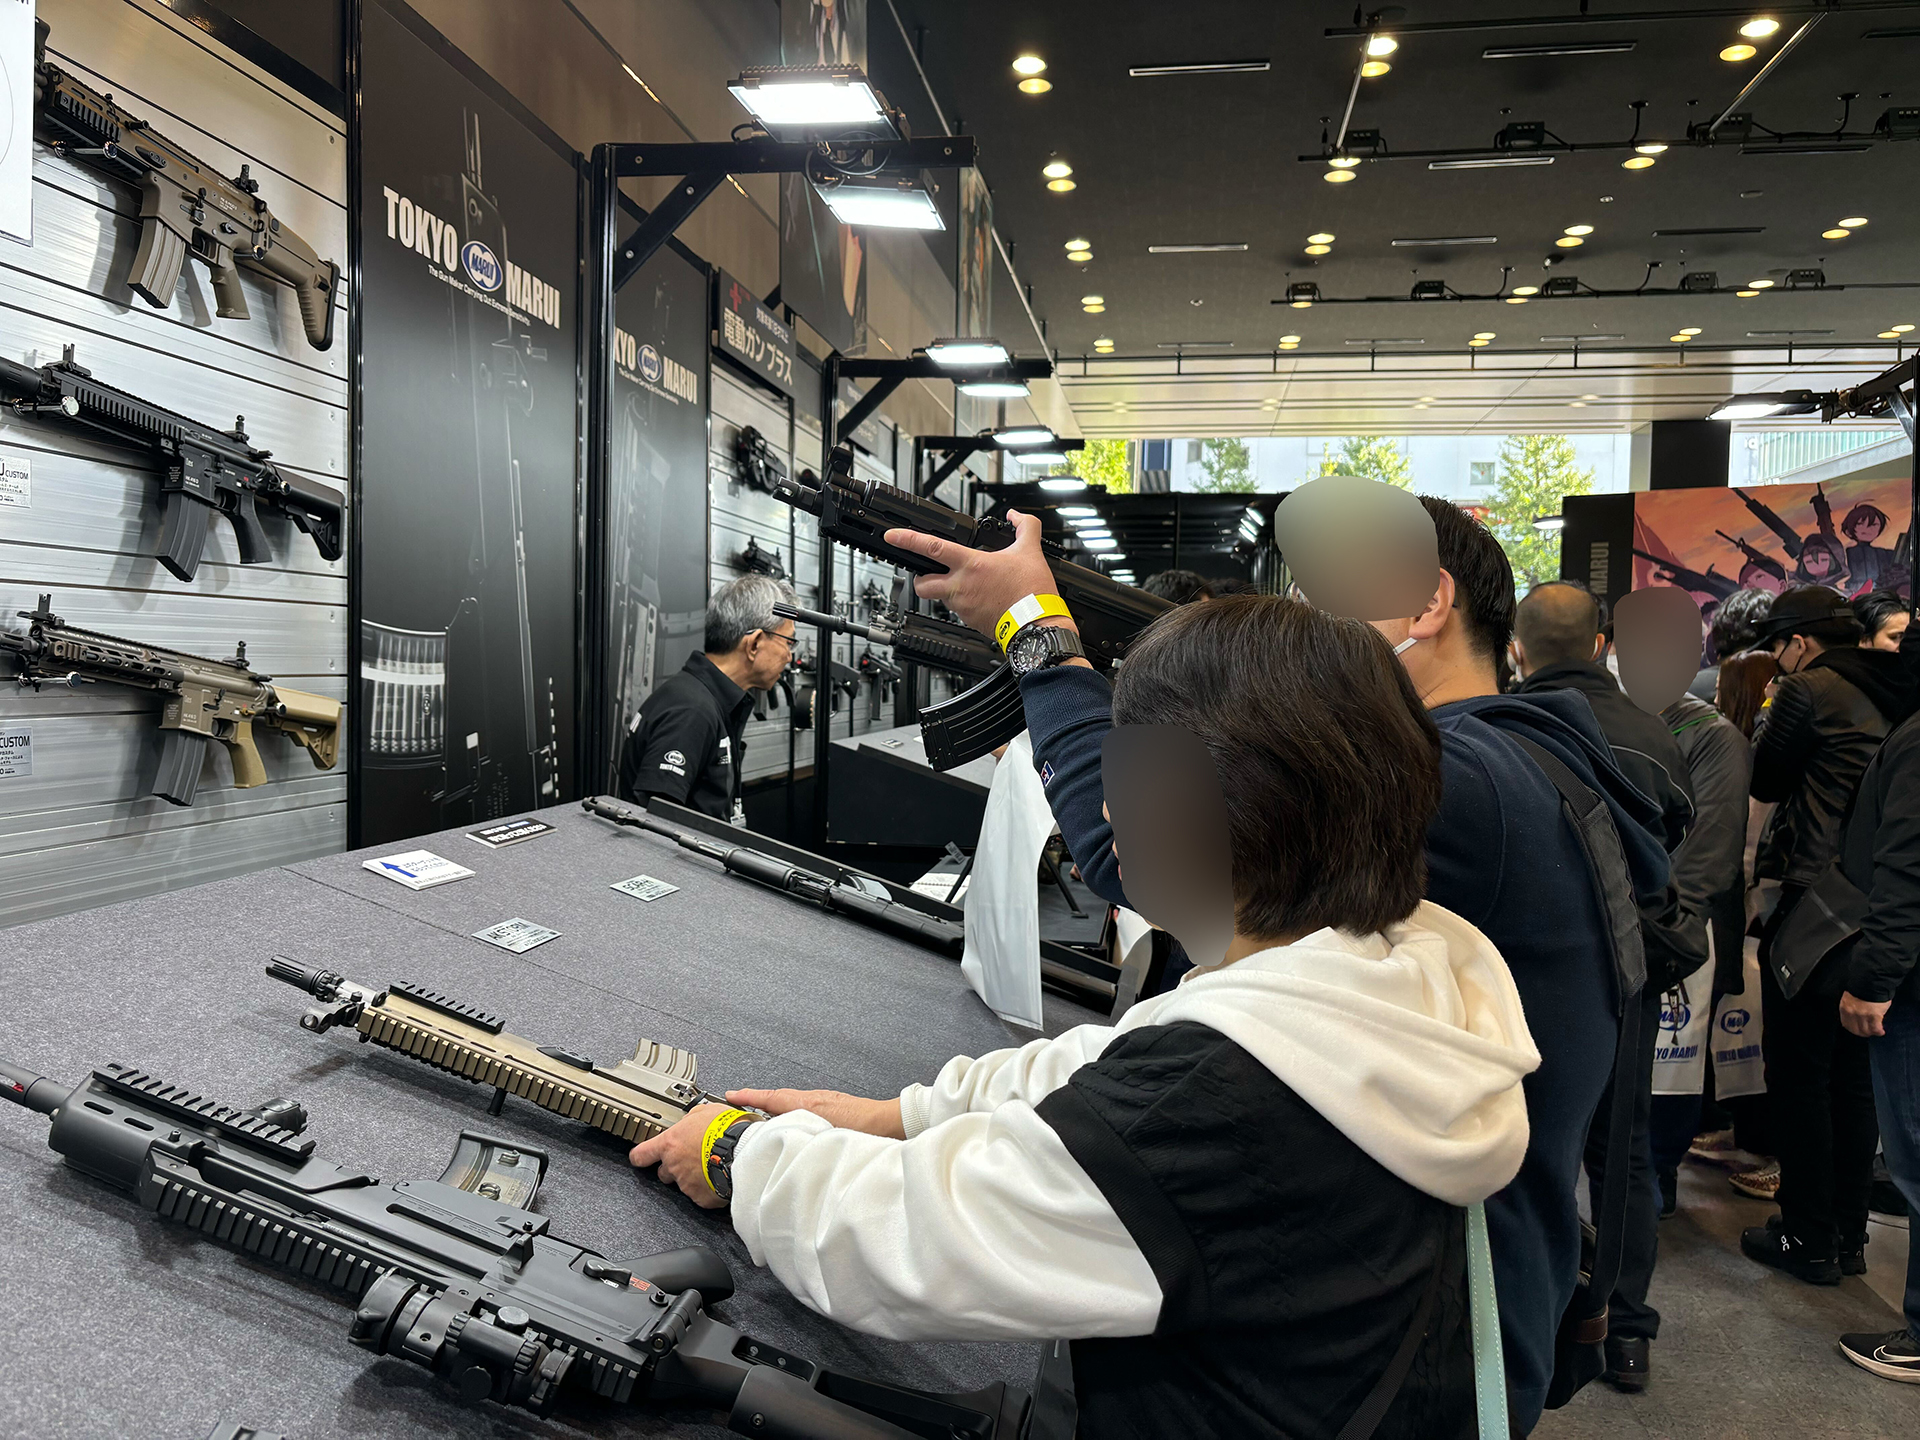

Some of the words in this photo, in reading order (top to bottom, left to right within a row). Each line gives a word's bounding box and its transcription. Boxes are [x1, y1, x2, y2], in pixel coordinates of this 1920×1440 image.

[383, 185, 458, 273] TOKYO
[505, 260, 561, 330] MARUI
[471, 253, 495, 281] MARUI
[428, 264, 439, 279] The
[438, 269, 450, 285] Gun
[463, 283, 484, 304] Carrying
[615, 326, 637, 372] KYO
[662, 355, 698, 406] MARUI
[723, 307, 765, 363] 電動ガン
[766, 343, 794, 387] プラス
[5, 469, 29, 480] CUSTOM
[1590, 541, 1609, 595] MARUI
[1669, 1045, 1698, 1060] MARUI
